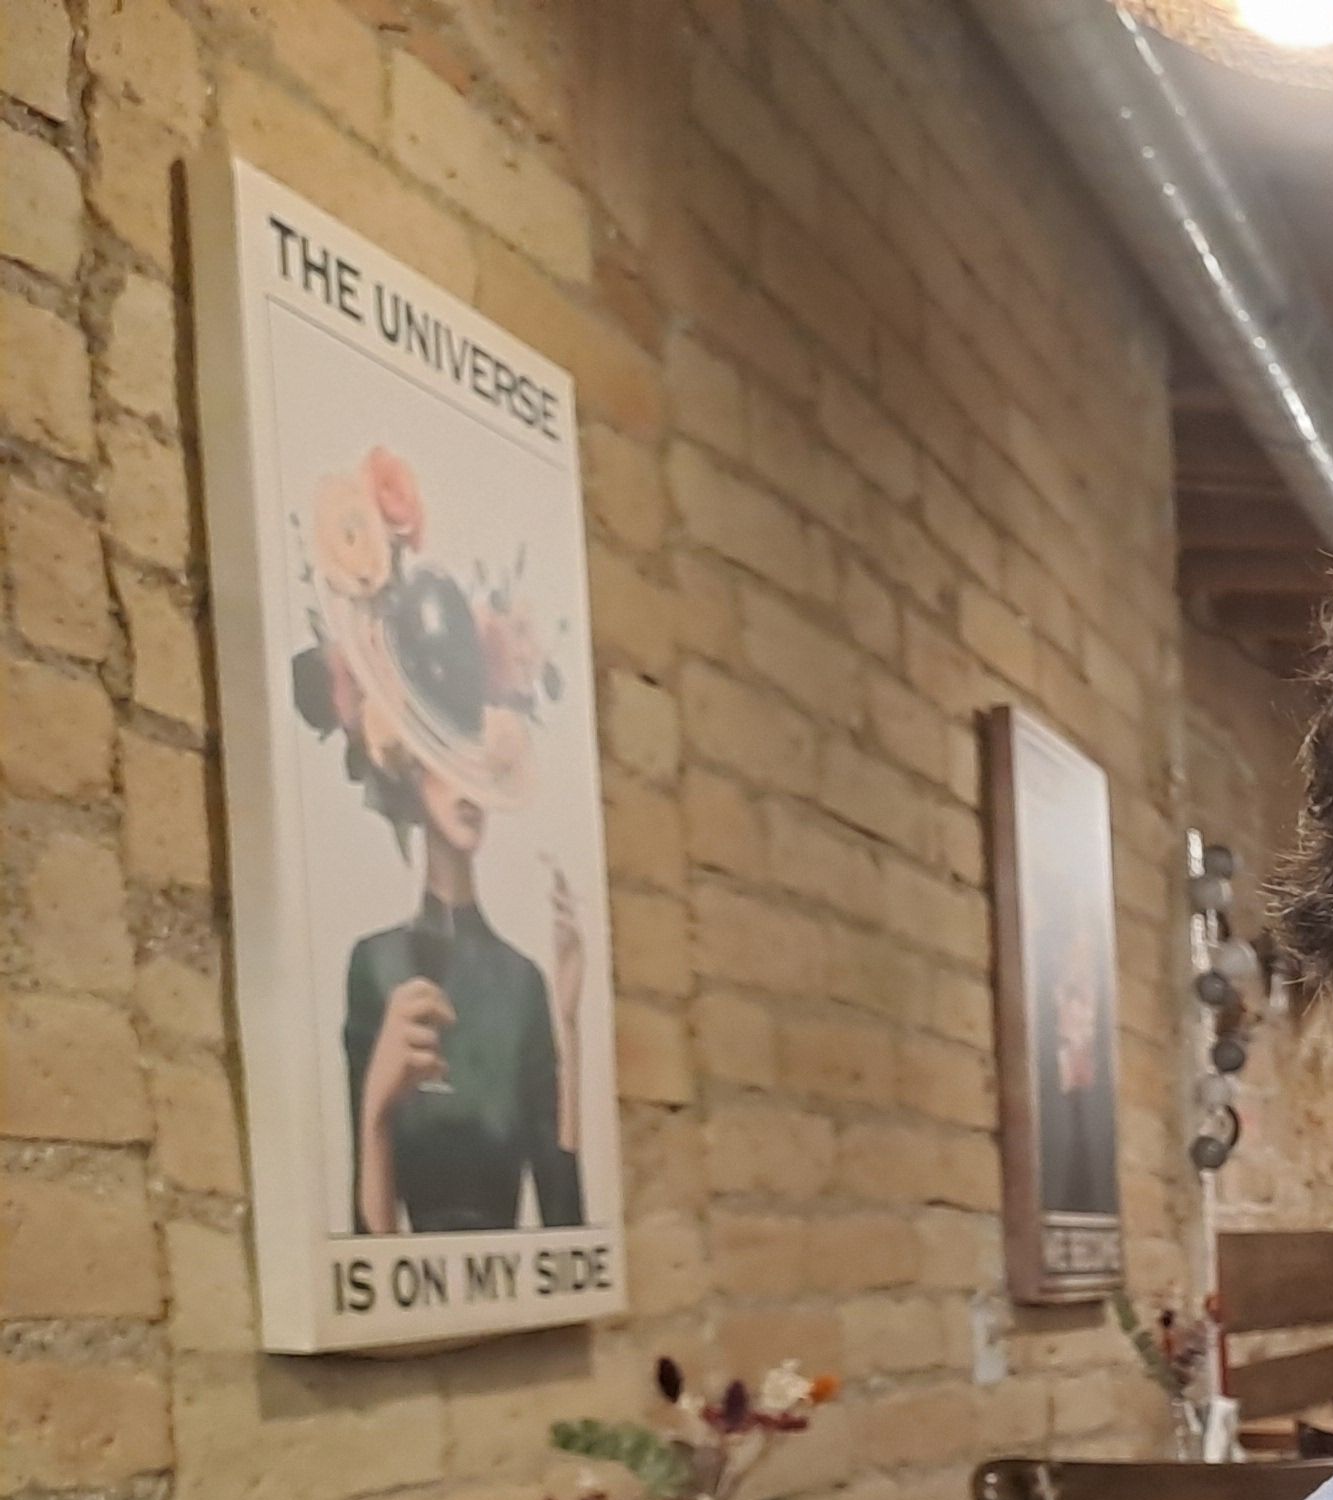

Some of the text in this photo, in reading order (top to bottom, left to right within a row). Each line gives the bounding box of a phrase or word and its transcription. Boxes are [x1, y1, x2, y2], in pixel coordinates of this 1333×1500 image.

[269, 215, 561, 443] THE UNIVERSE
[331, 1245, 613, 1315] IS ON MY SIDE
